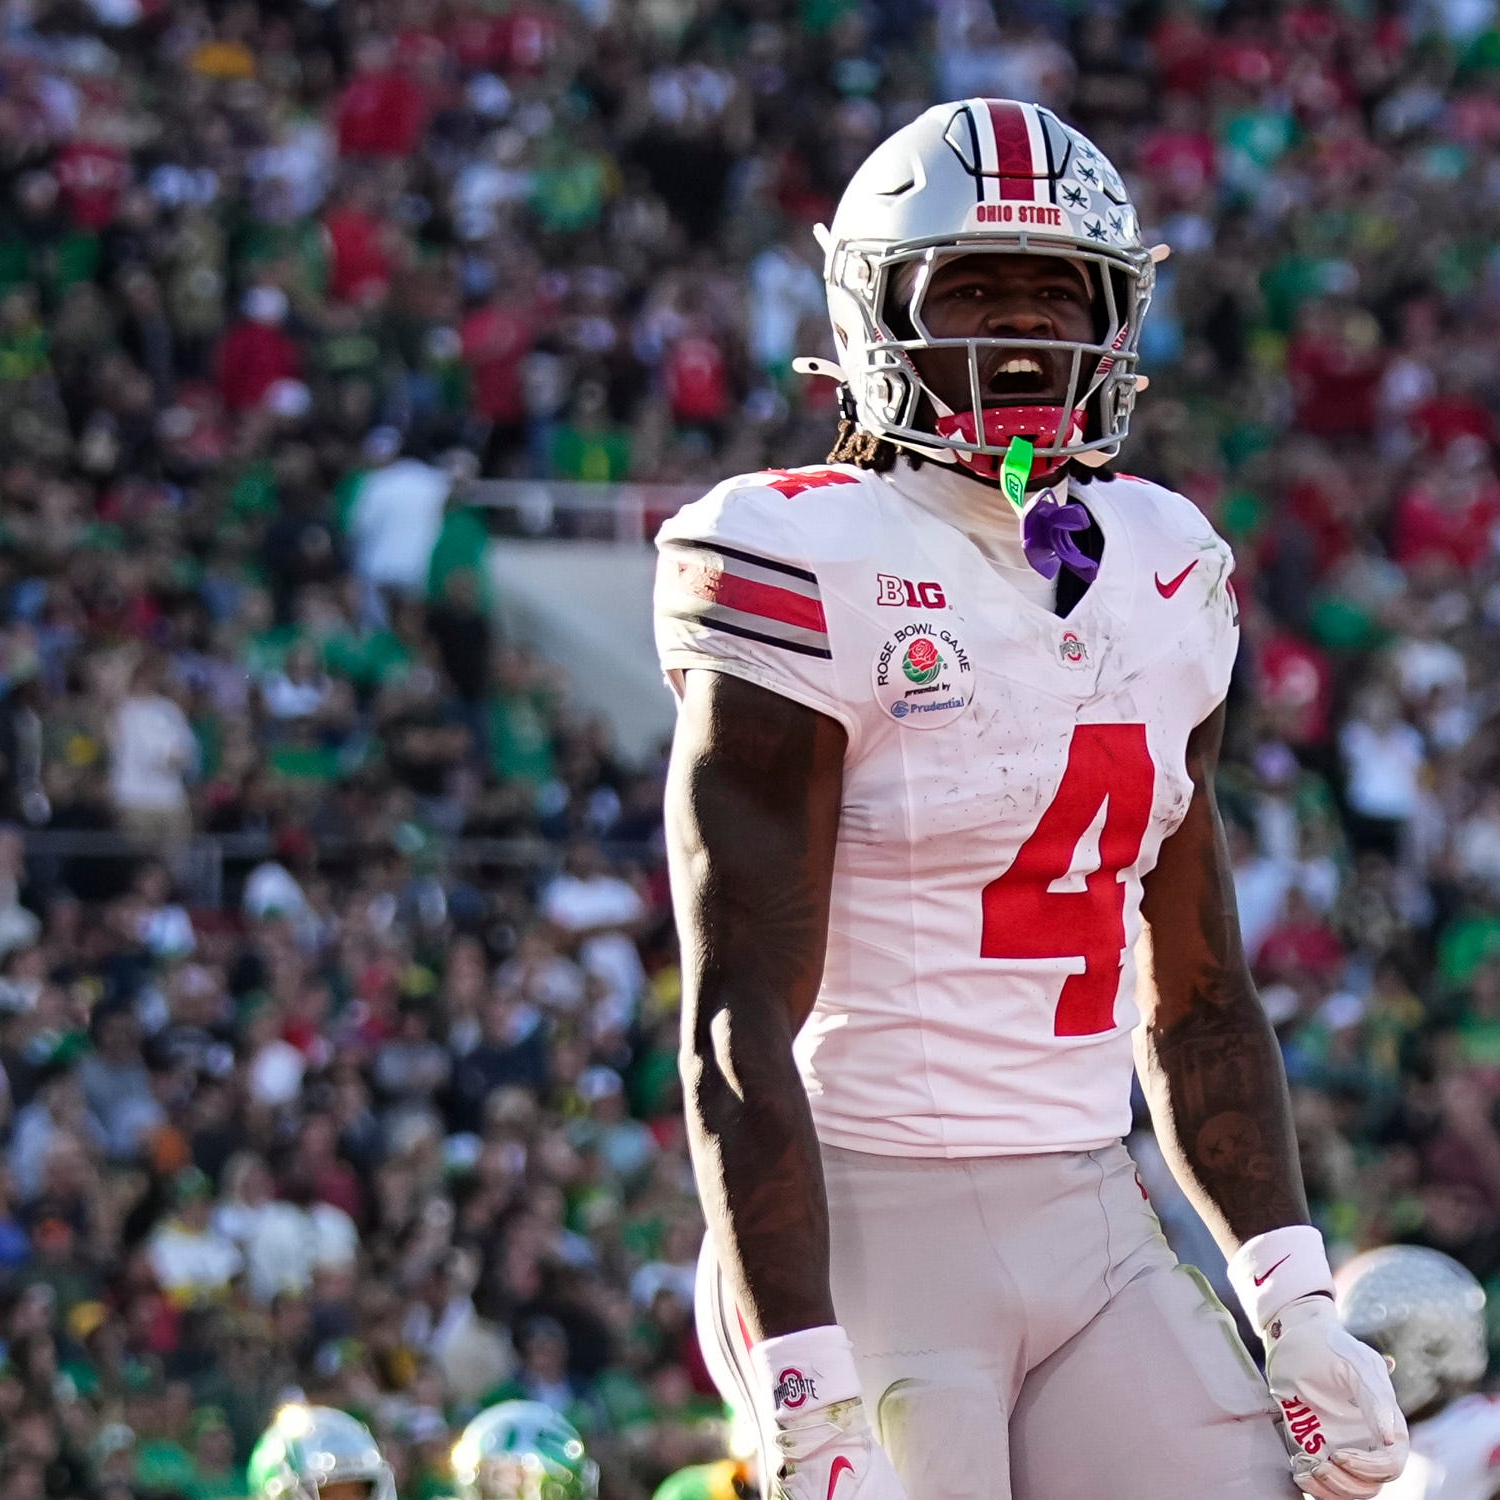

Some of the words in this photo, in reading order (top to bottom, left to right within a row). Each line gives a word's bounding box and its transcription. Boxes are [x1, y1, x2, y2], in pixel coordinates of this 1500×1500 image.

[977, 205, 1012, 222] OHIO
[1019, 206, 1061, 226] STATE
[877, 641, 897, 686] ROSE
[894, 623, 937, 642] BOWL
[940, 630, 970, 673] GAME
[904, 683, 939, 698] presented
[910, 697, 965, 714] Prudential
[980, 723, 1155, 1036] 4
[1281, 1395, 1327, 1455] STATE
